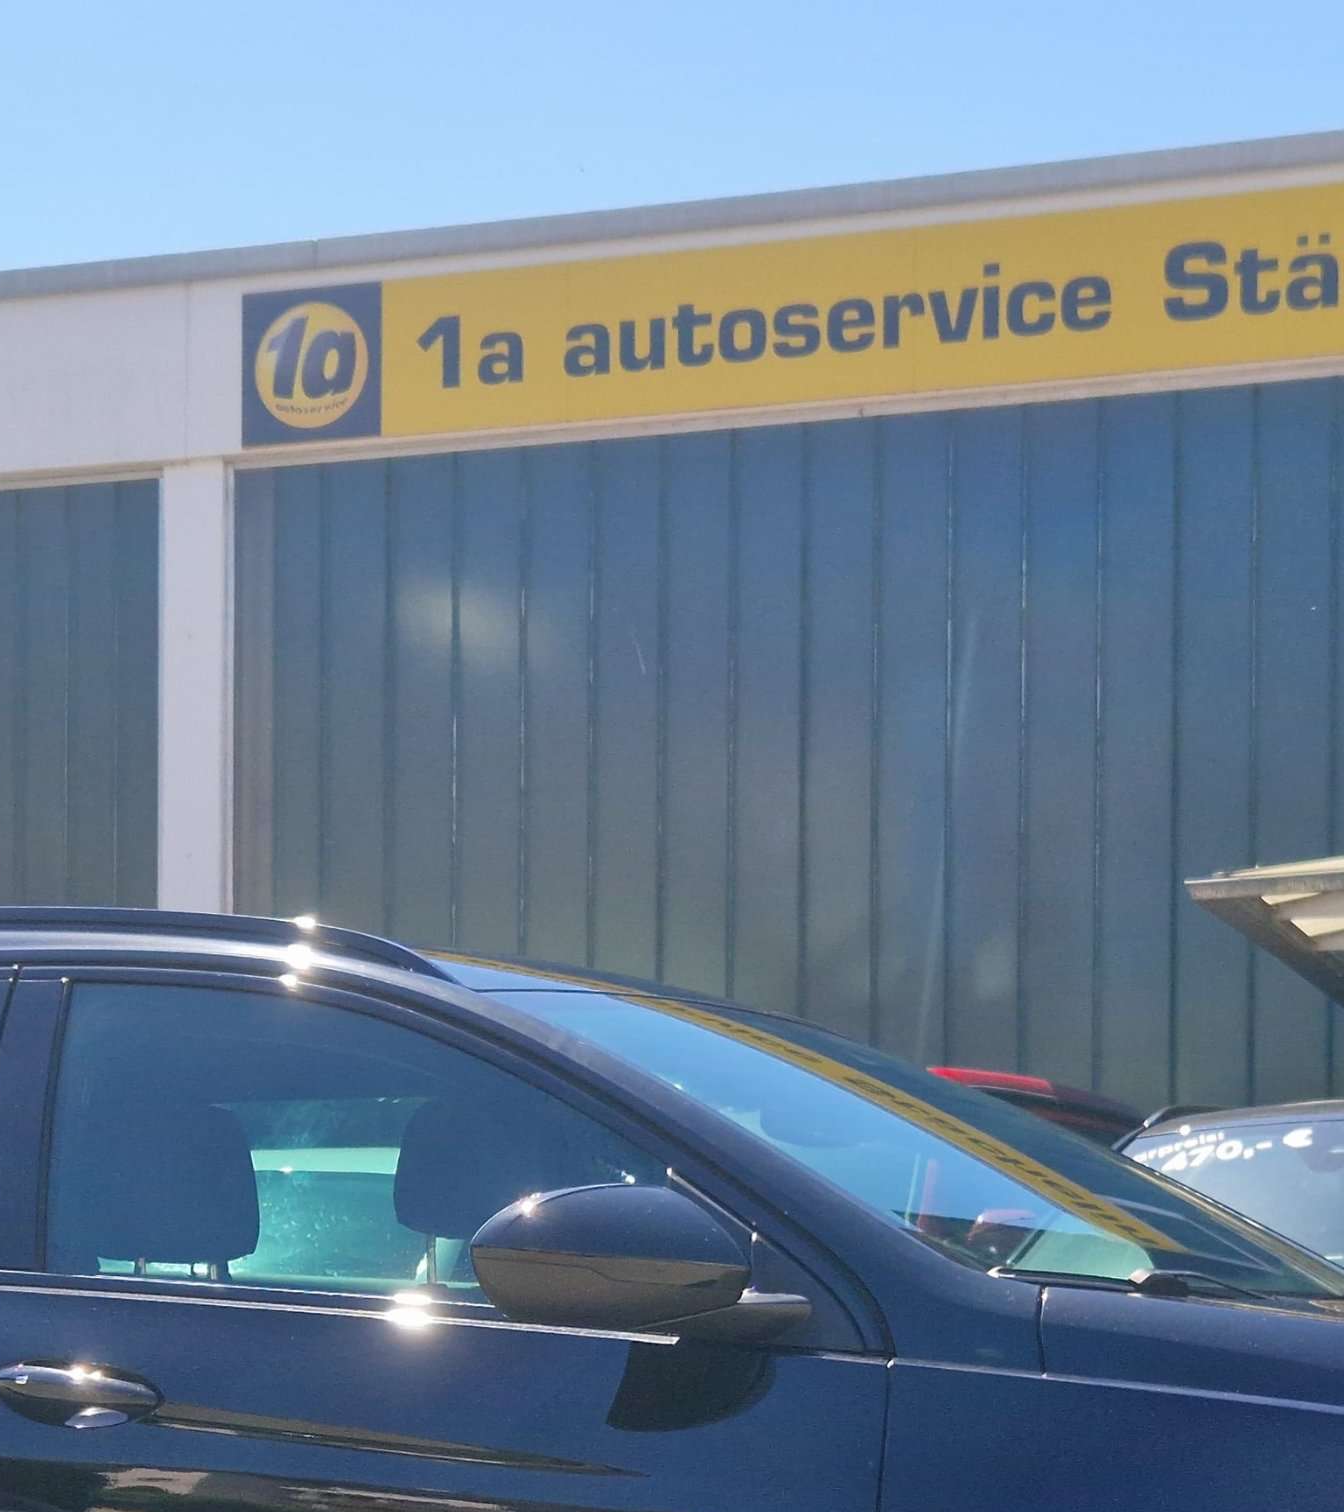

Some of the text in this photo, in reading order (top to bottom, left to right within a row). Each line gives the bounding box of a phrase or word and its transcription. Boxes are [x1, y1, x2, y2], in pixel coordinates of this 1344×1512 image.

[267, 315, 356, 399] 1a
[416, 314, 523, 389] 1a
[563, 262, 1112, 378] autoservice
